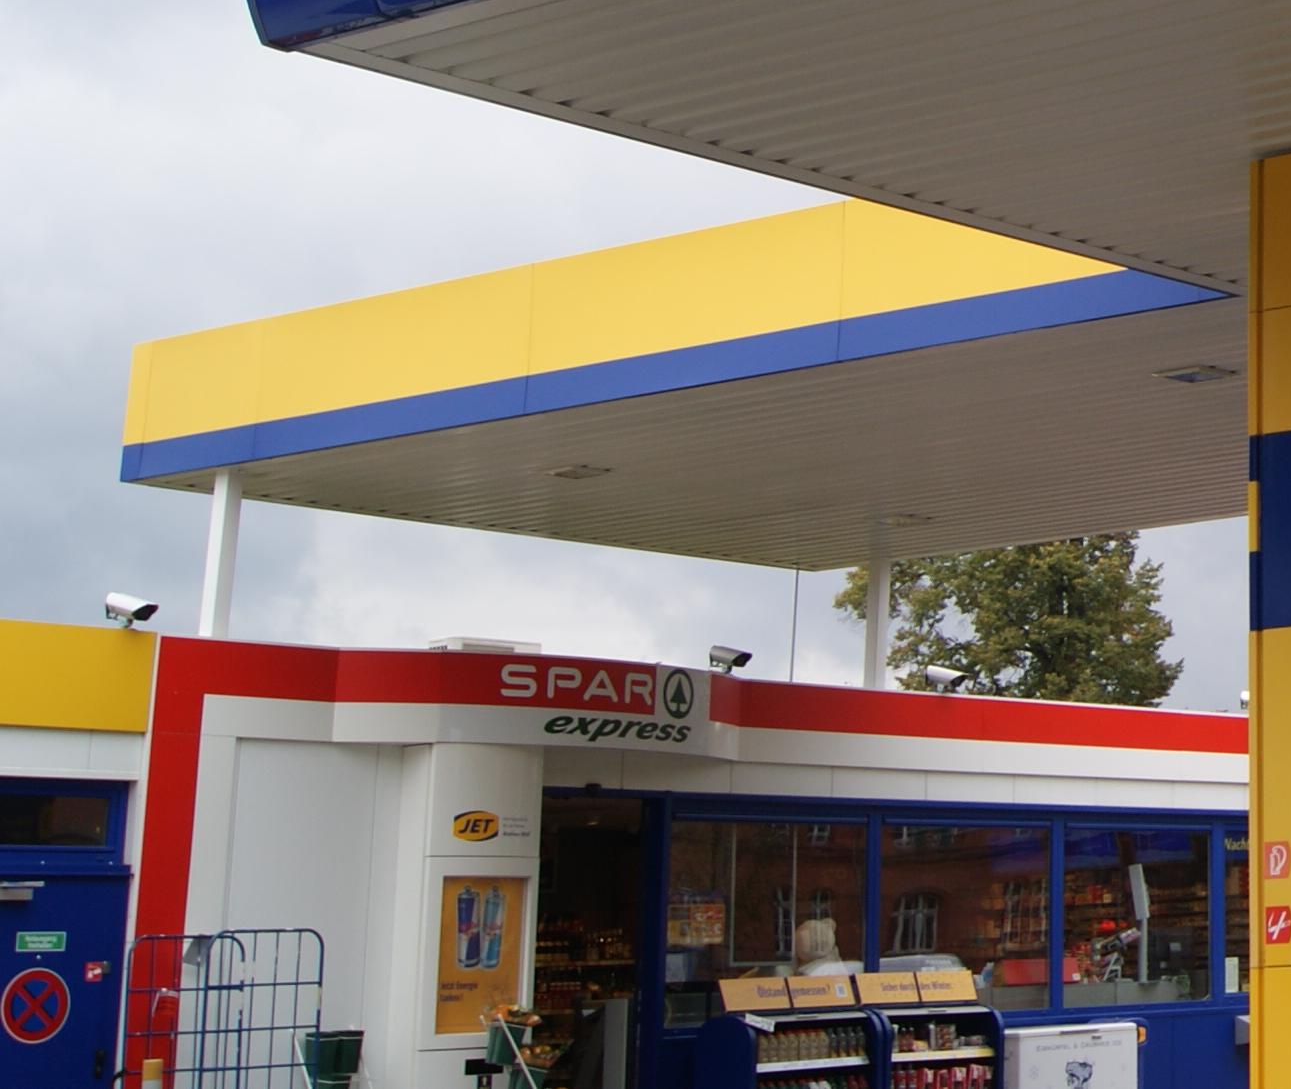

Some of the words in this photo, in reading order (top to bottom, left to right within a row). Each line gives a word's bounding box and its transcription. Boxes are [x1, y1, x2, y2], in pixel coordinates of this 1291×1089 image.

[500, 663, 653, 706] SPAR
[543, 715, 691, 743] express
[458, 819, 494, 834] JET
